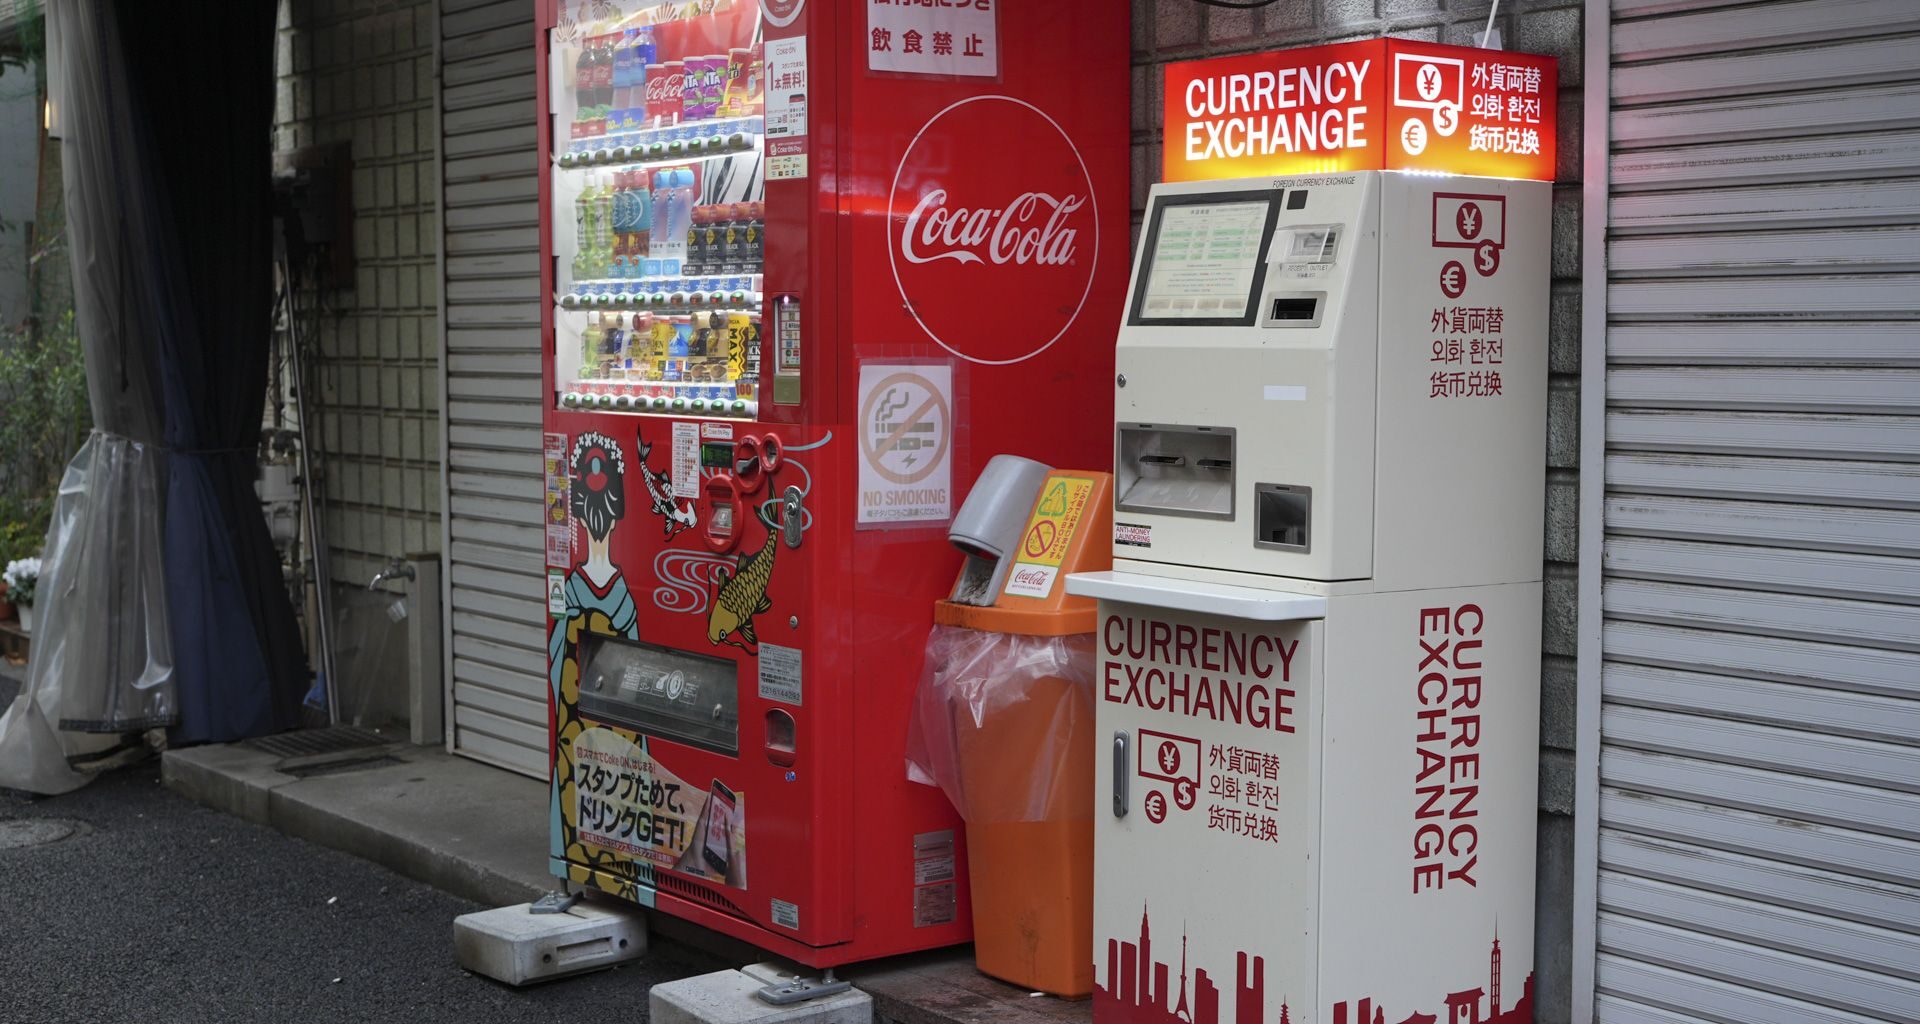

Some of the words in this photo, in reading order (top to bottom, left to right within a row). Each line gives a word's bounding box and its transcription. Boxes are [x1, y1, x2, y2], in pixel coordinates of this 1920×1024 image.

[871, 27, 984, 57] 飲食禁止
[684, 74, 698, 90] NTA
[704, 71, 720, 87] NTA
[1185, 59, 1371, 118] CURRENCY
[1471, 62, 1541, 94] 外貨両替
[1471, 95, 1503, 119] 외화
[1507, 97, 1541, 124] 환전
[1185, 106, 1368, 160] EXCHANGE
[1469, 126, 1541, 155] 货币兑换
[1273, 180, 1295, 188] FOREIGN
[1297, 178, 1324, 187] CURRENCY
[1326, 177, 1355, 186] EXCHANGE
[902, 189, 1087, 266] Coca-Cola
[1431, 307, 1503, 334] 外貨両替
[729, 328, 738, 362] MAX
[1430, 338, 1465, 365] 외화
[1469, 338, 1503, 365] 환전
[736, 384, 752, 396] 100
[1430, 371, 1503, 398] 货币兑换
[864, 491, 882, 507] NO
[886, 489, 946, 506] SMOKING
[1116, 526, 1151, 536] ANTI-MONEY
[1116, 532, 1151, 543] LAUNDERING
[1104, 615, 1299, 683] CURRENCY
[1104, 662, 1296, 734] EXCHANGE
[1414, 607, 1451, 894] EXCHANGE
[1447, 604, 1484, 888] CURRENCY
[1209, 743, 1280, 782] 外貨両替
[578, 763, 686, 815] スタンプためて、
[1208, 774, 1241, 803] 외화
[1245, 779, 1280, 812] 환전
[580, 795, 685, 852] ドリンクGET!
[1208, 806, 1279, 843] 货币兑换
